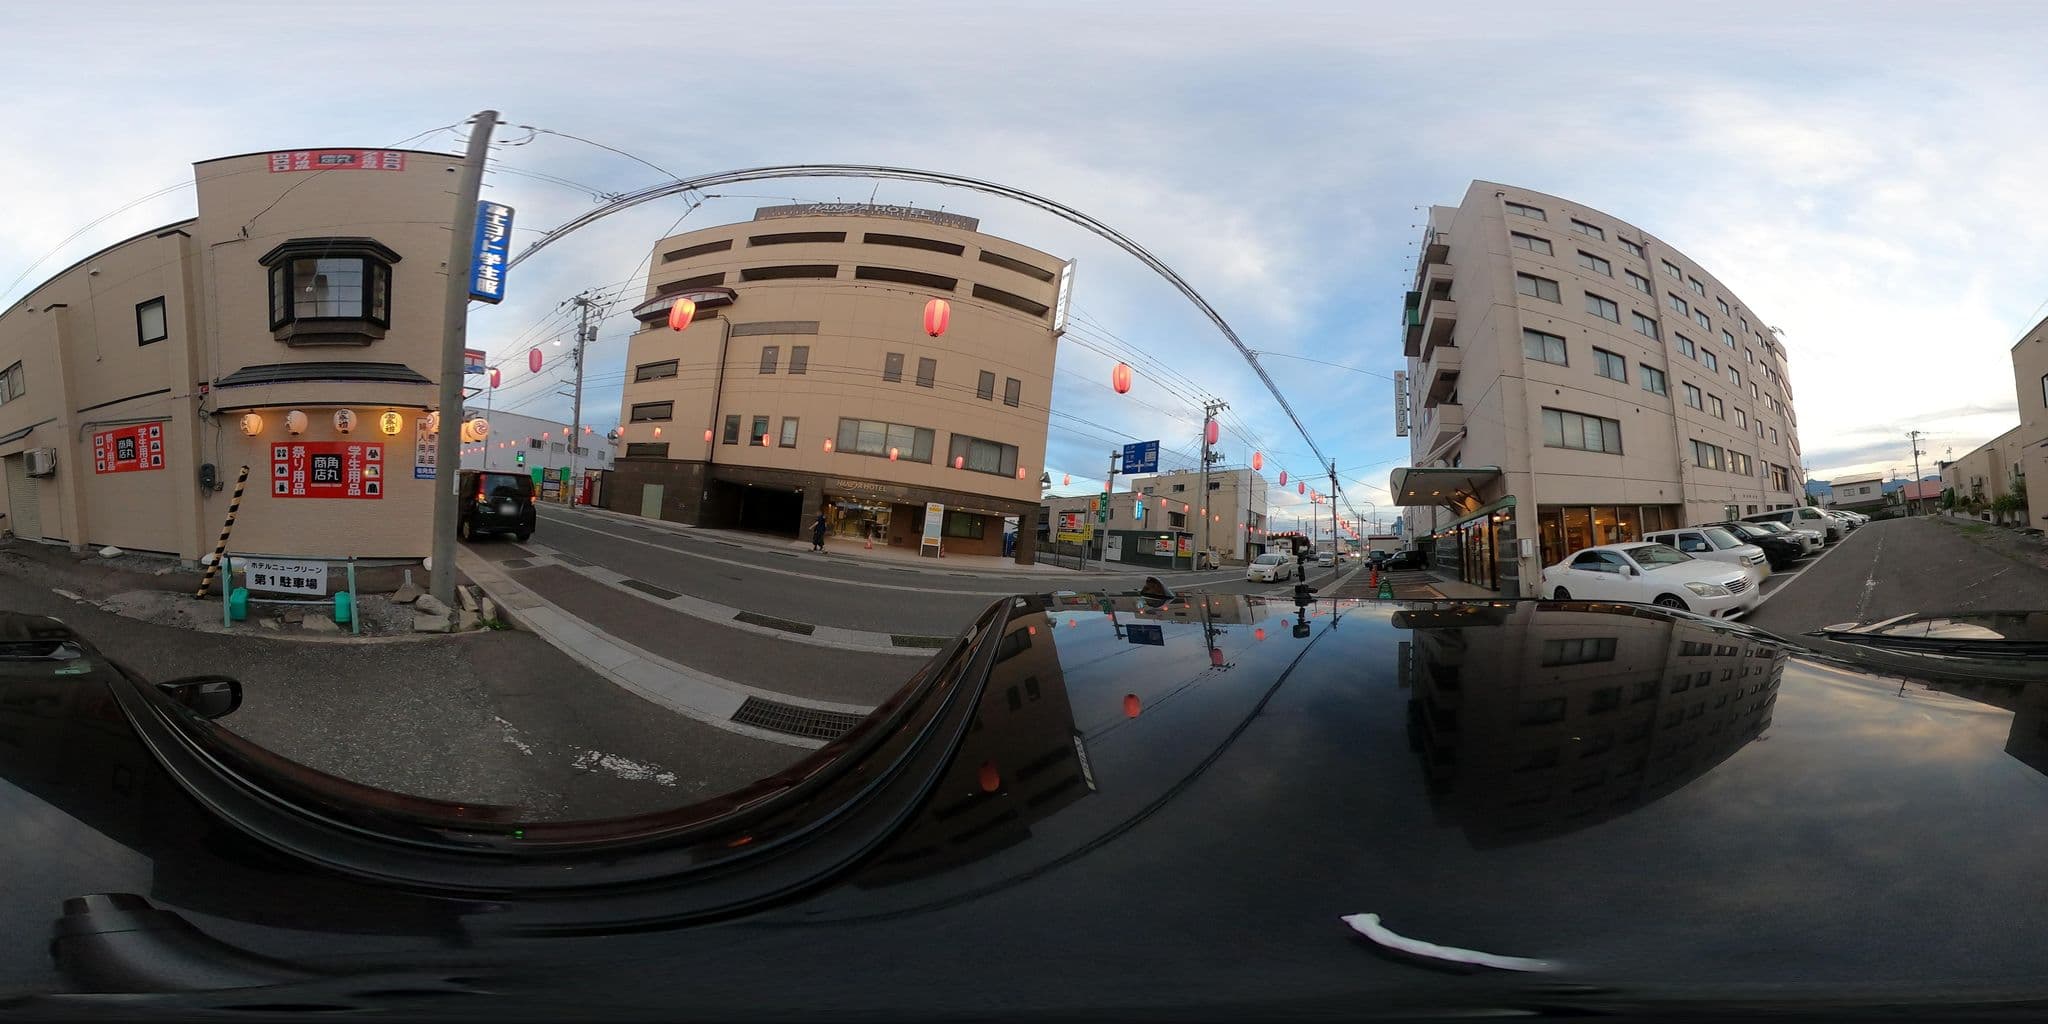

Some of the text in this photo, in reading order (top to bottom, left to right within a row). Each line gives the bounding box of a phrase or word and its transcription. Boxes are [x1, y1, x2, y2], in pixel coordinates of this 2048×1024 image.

[874, 206, 931, 217] HOTEL
[292, 446, 305, 495] 祭り用品
[347, 445, 361, 496] 学生用品
[863, 482, 887, 492] HOTEL
[251, 562, 322, 574] ホテルニューグリーン
[254, 574, 318, 590] 第1駐車場
